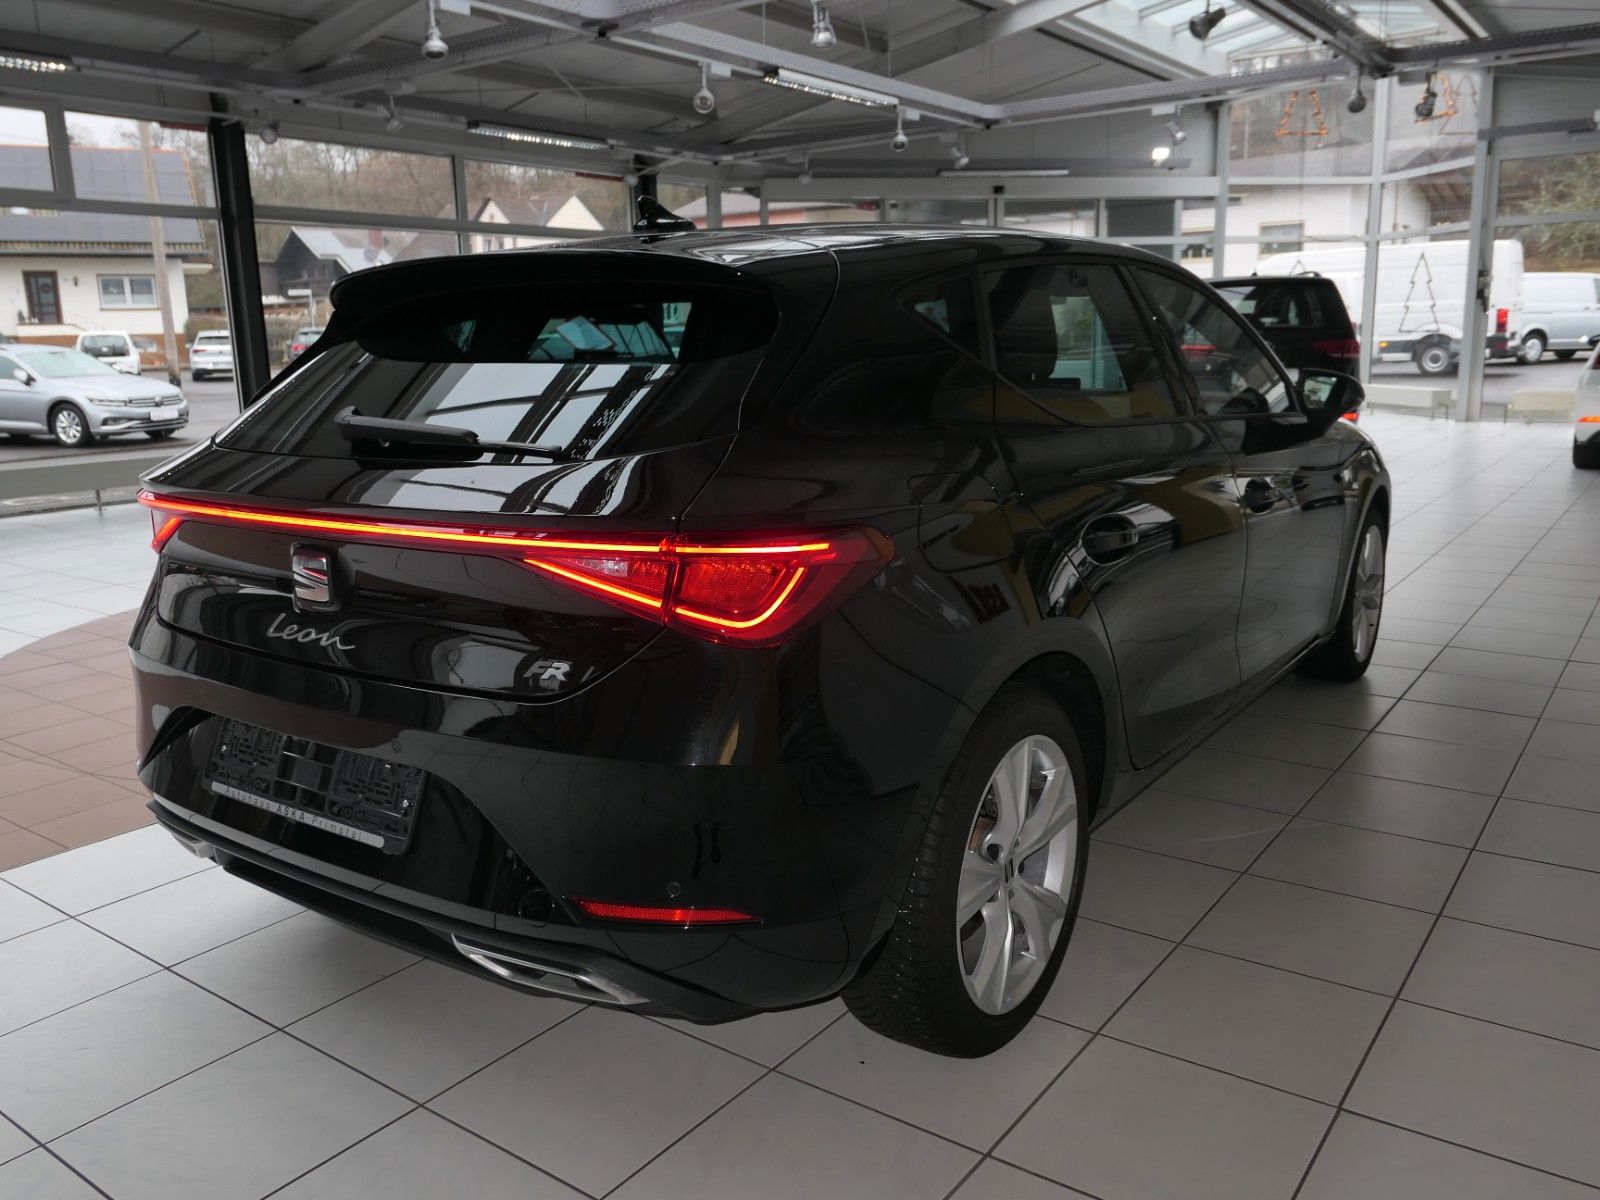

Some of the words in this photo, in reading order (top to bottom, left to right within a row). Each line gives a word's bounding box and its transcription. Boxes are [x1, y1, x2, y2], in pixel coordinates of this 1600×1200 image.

[267, 612, 355, 650] Leon
[523, 660, 570, 682] FR
[224, 786, 271, 810] Autohaus
[276, 804, 305, 822] ASKA
